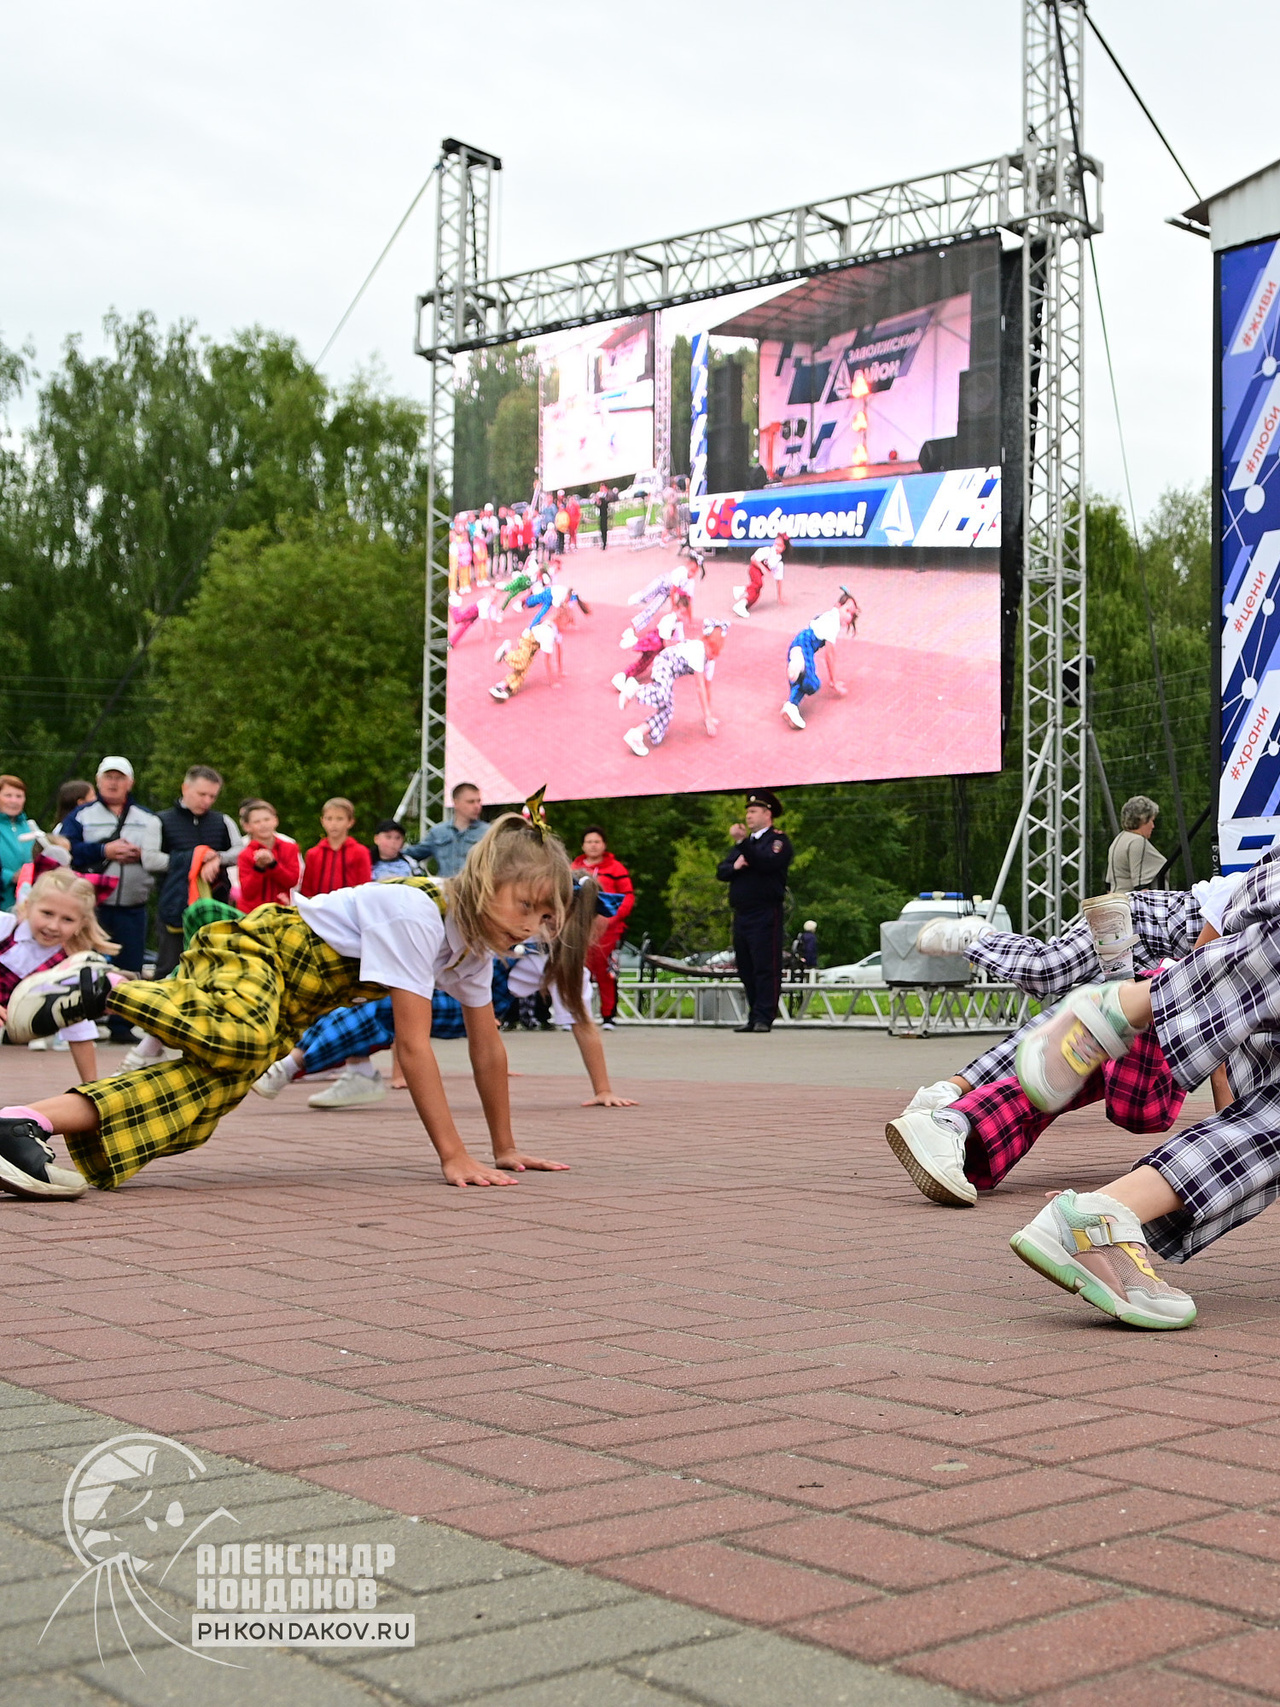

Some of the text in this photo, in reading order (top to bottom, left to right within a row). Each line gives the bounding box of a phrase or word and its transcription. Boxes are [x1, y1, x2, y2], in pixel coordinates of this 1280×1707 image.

[1242, 280, 1278, 347] #живи
[1244, 405, 1280, 474] #люби
[750, 501, 868, 539] юбилеем!
[1233, 570, 1267, 633] #цени
[1230, 706, 1270, 781] #храни
